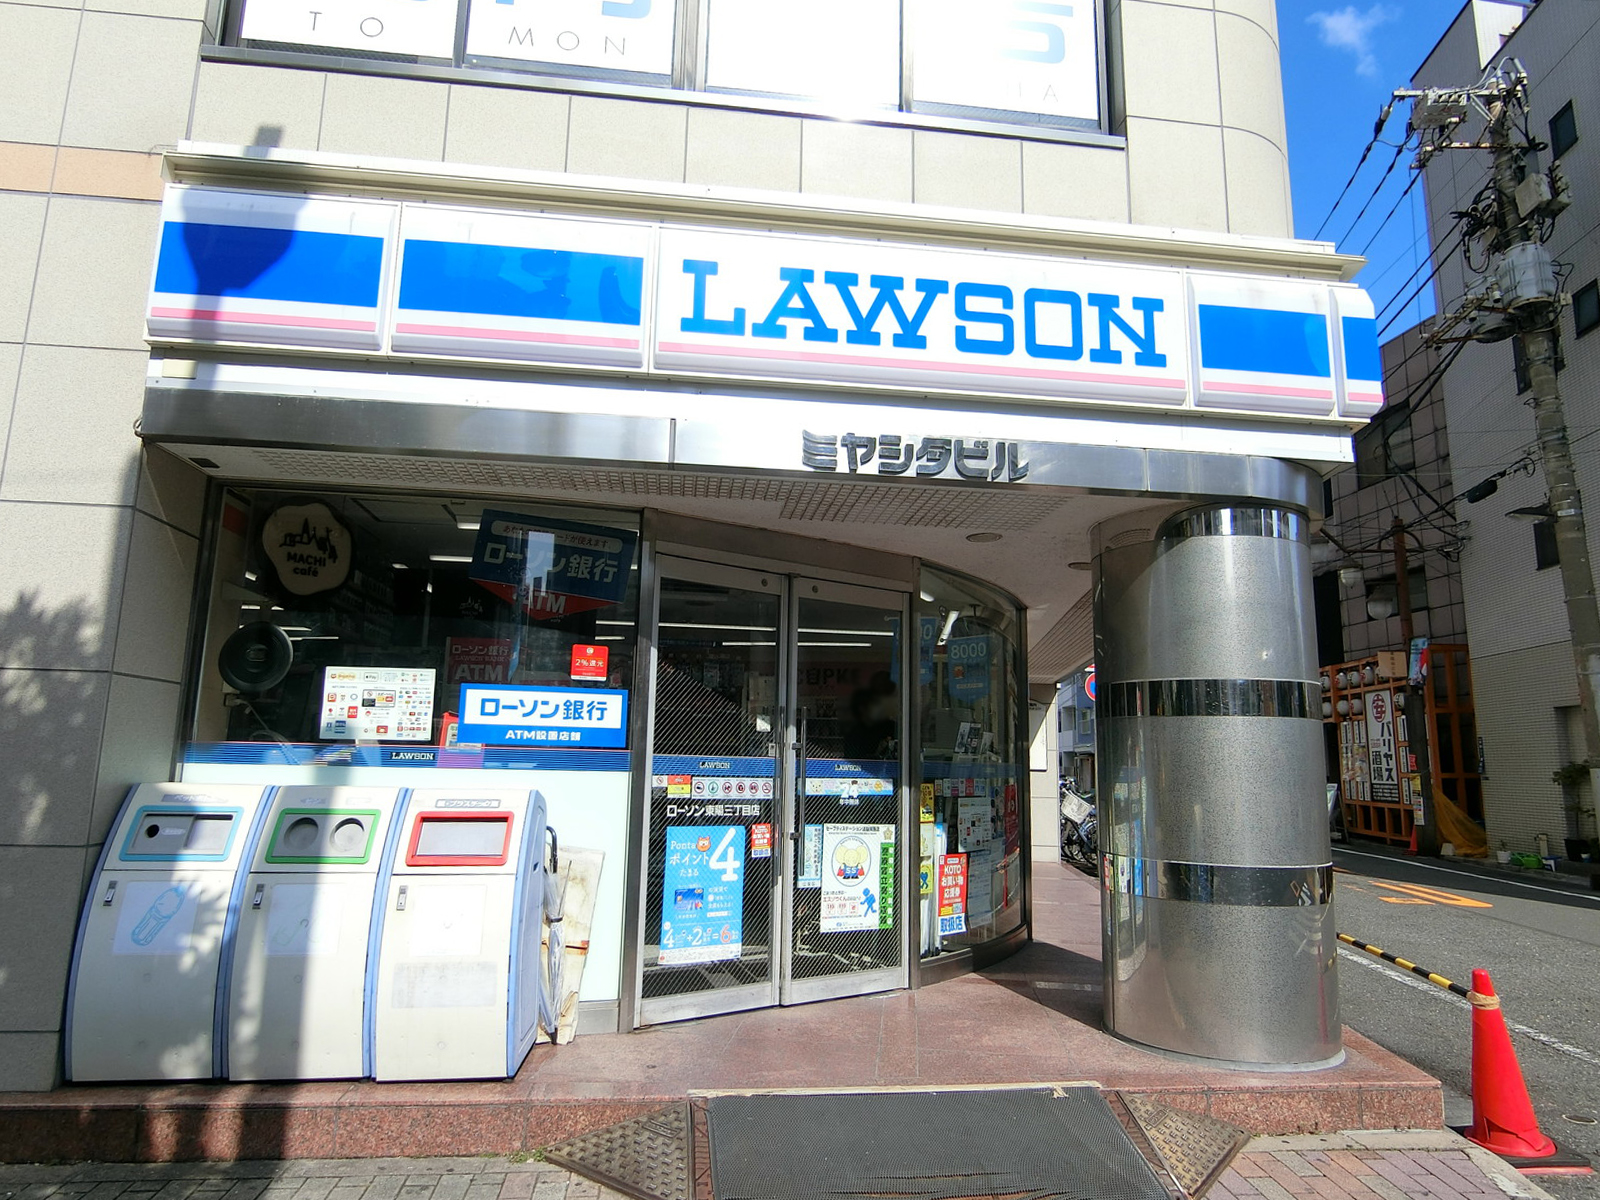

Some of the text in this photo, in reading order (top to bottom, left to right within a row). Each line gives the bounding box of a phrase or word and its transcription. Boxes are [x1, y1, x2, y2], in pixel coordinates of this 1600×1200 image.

[680, 259, 1167, 368] LAWSON
[802, 432, 1029, 481] ミヤシタビル
[286, 551, 327, 567] MACHI
[483, 542, 618, 583] ローソン銀行
[523, 590, 567, 614] ATM
[452, 644, 510, 656] ローソン銀行
[950, 642, 987, 660] 8000
[455, 664, 504, 682] ATM
[480, 697, 608, 721] ローソン銀行
[505, 729, 581, 742] ATM設置店舗
[391, 752, 435, 760] LAWSON
[1380, 720, 1395, 783] バリヤス
[699, 761, 731, 769] LAWSON
[670, 840, 697, 850] Ponta
[708, 827, 741, 881] 4
[669, 853, 709, 866] ポイント
[944, 864, 962, 874] KOTO
[940, 915, 963, 934] 取扱店
[663, 927, 675, 948] 4
[720, 923, 732, 944] 6
